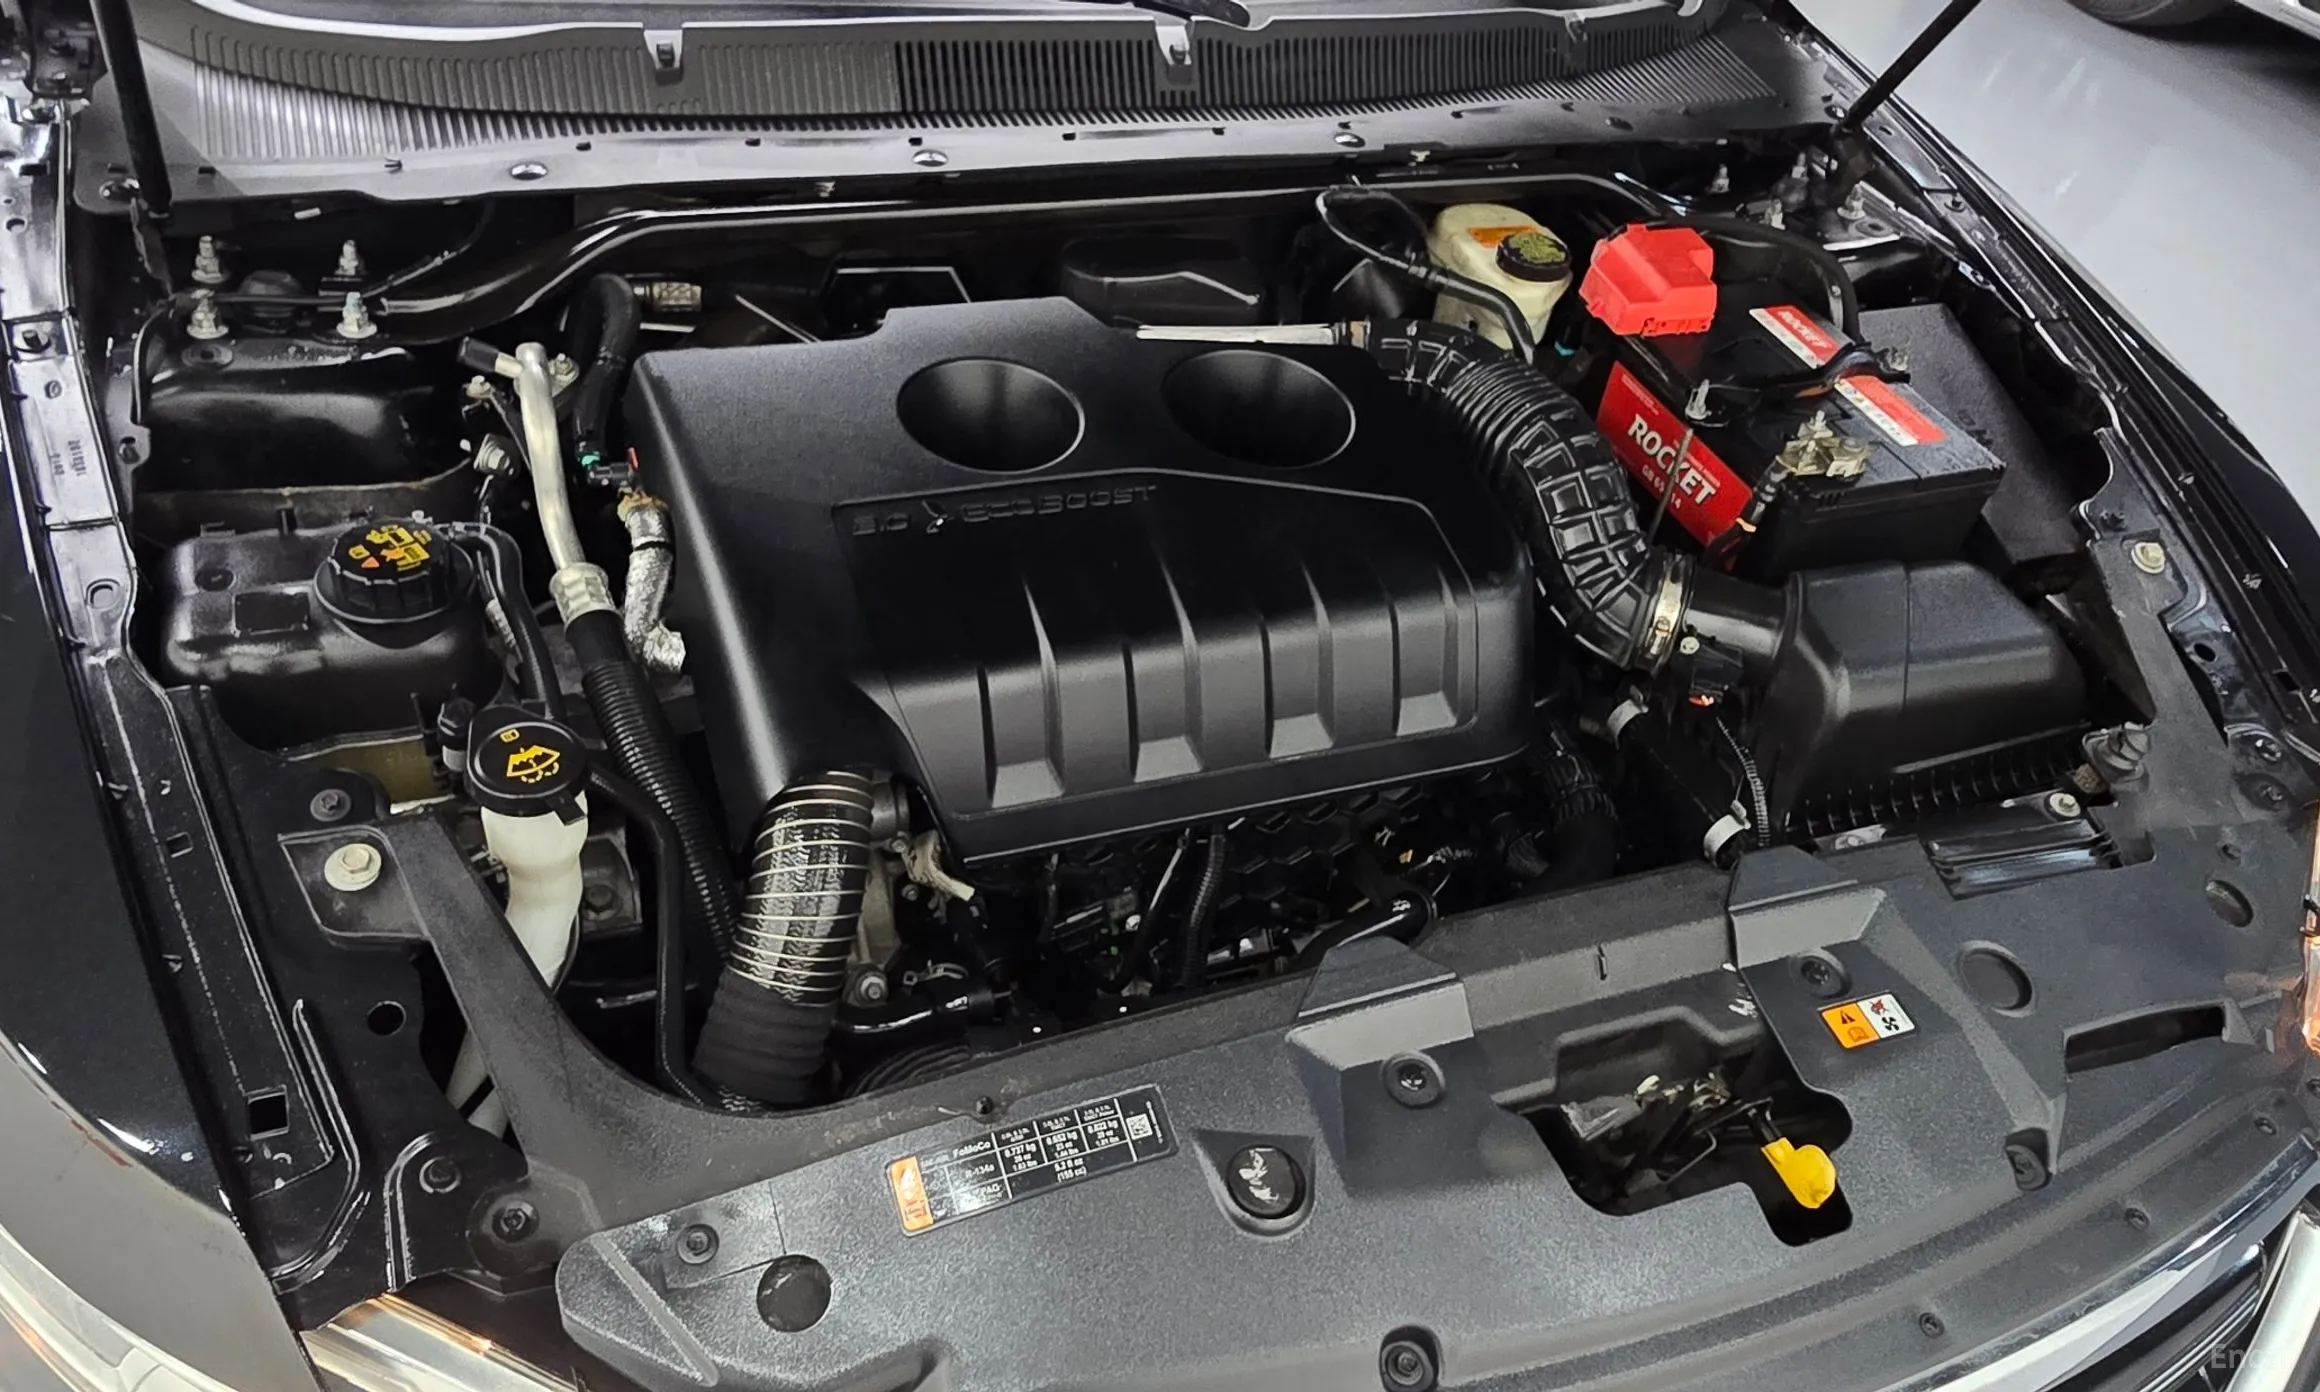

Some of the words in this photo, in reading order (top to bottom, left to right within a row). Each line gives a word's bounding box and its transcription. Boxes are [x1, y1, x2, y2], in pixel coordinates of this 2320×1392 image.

[1627, 413, 1718, 505] ROCKET
[960, 485, 1158, 523] ECOBOOST
[952, 1140, 991, 1158] FoMoCo
